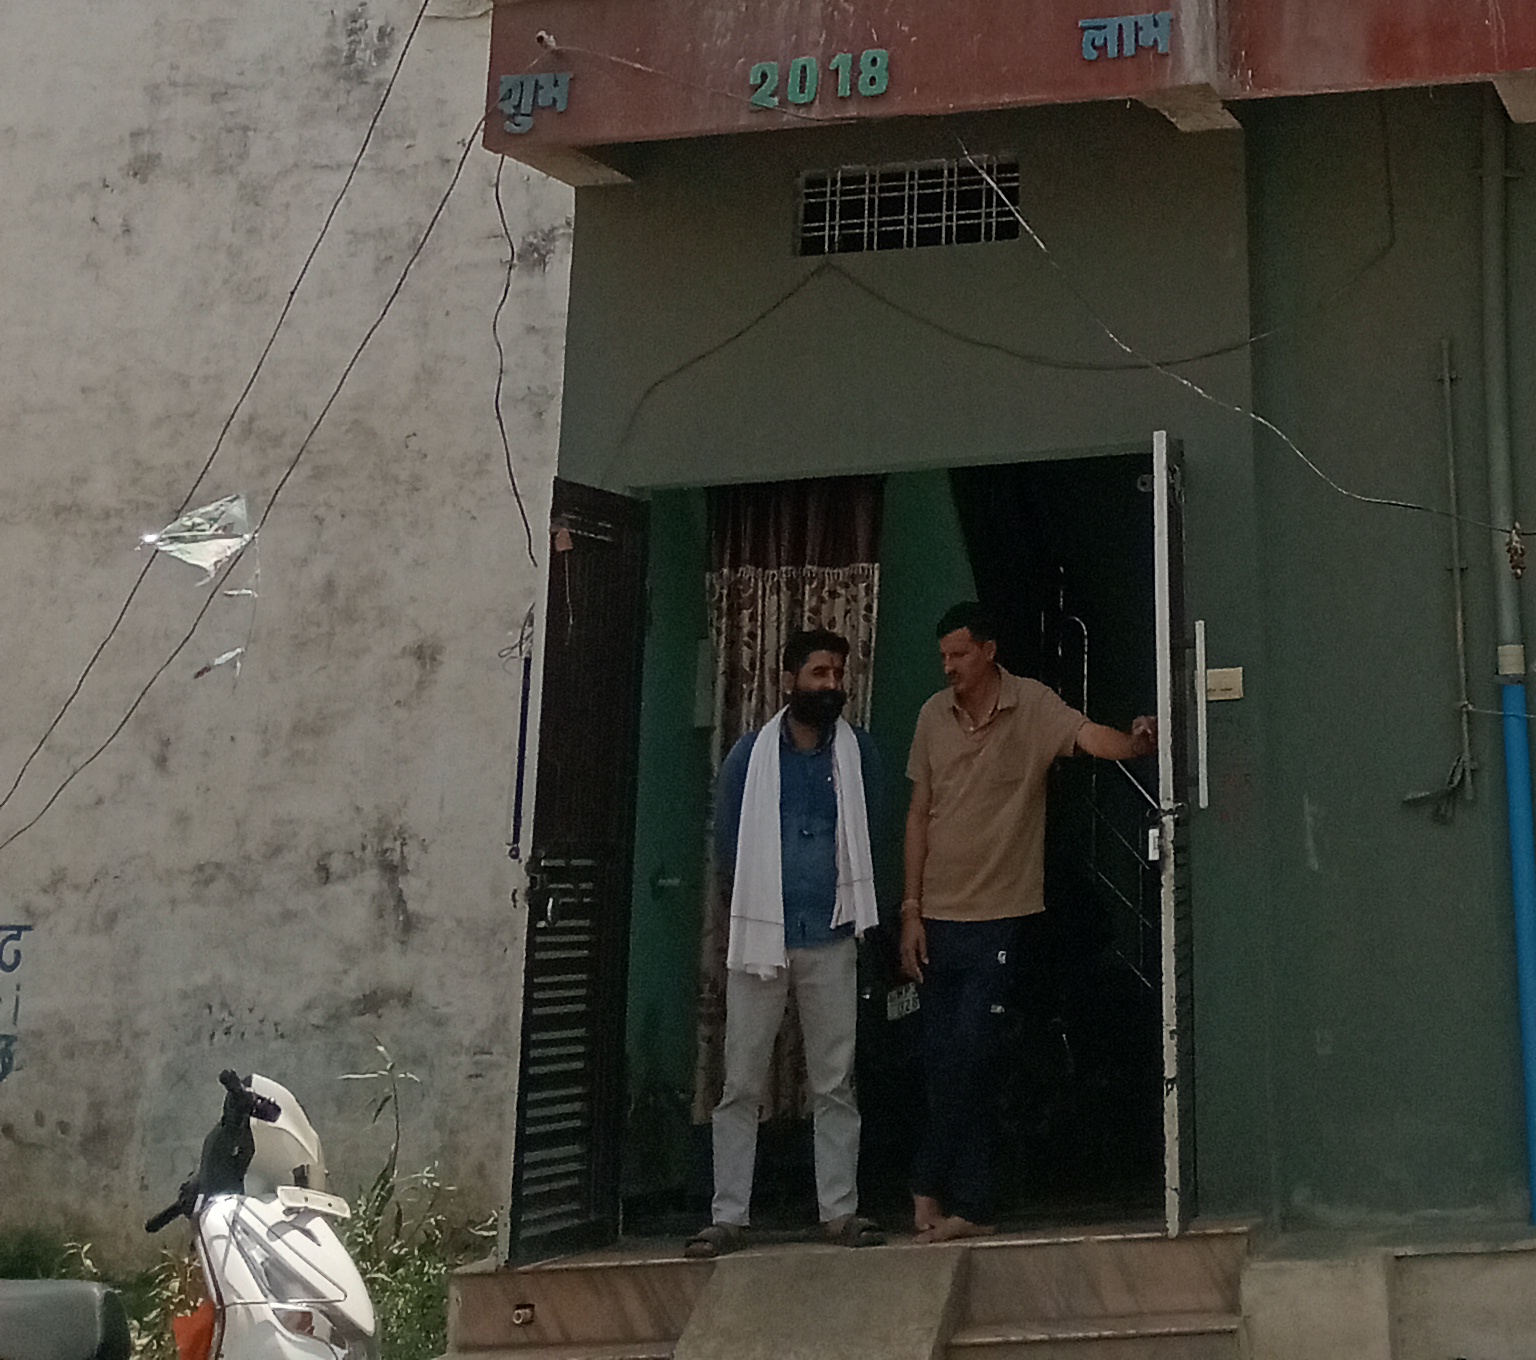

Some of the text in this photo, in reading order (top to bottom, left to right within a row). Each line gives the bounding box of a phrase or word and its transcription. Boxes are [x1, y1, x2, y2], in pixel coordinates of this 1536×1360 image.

[1079, 11, 1173, 61] लाभ
[498, 72, 574, 134] शुभ
[749, 48, 890, 109] 2018
